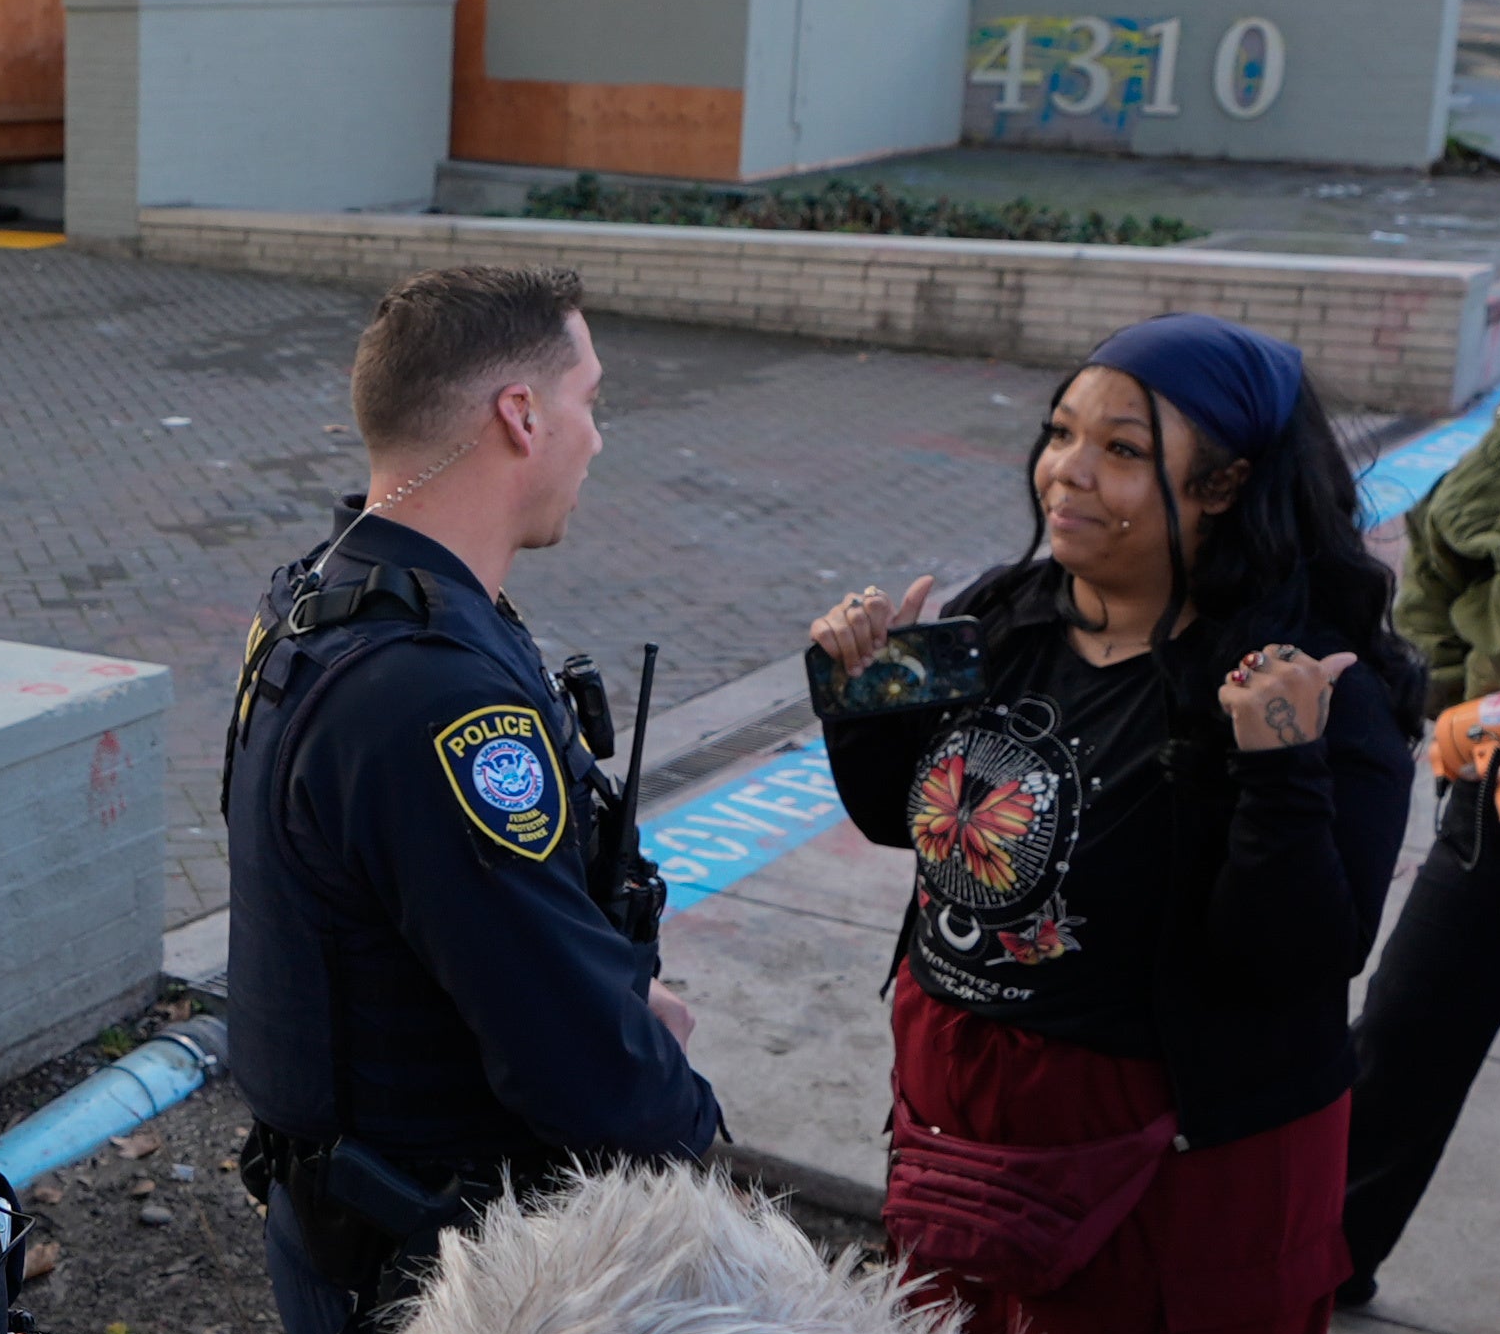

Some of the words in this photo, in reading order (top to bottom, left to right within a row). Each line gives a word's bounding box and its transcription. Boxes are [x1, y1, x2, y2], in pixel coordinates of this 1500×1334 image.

[970, 15, 1286, 120] 4310
[447, 715, 533, 758] POLICE
[642, 748, 843, 884] GOVER
